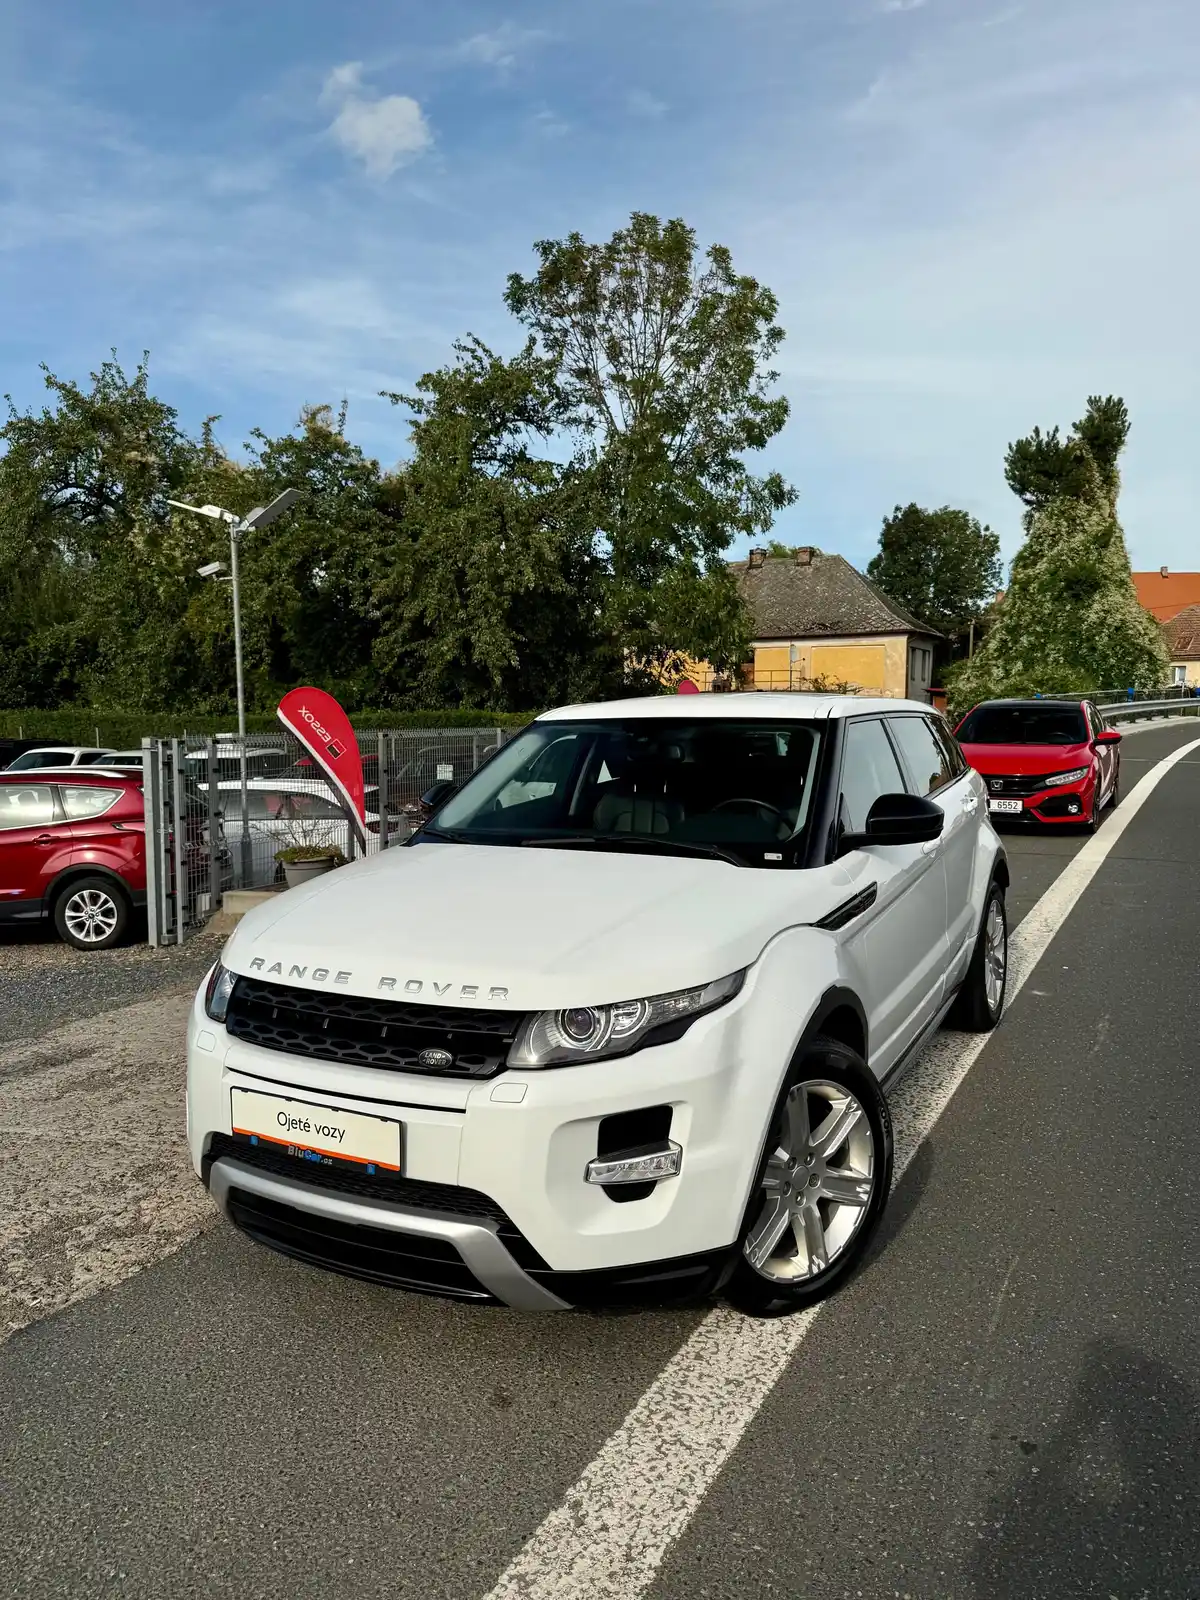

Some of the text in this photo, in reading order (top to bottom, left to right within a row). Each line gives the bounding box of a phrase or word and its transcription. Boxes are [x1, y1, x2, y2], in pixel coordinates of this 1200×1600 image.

[997, 801, 1018, 809] 6552
[249, 957, 510, 1001] RANGE ROVER
[424, 1052, 442, 1060] LAND
[276, 1111, 346, 1143] Ojeté vozy
